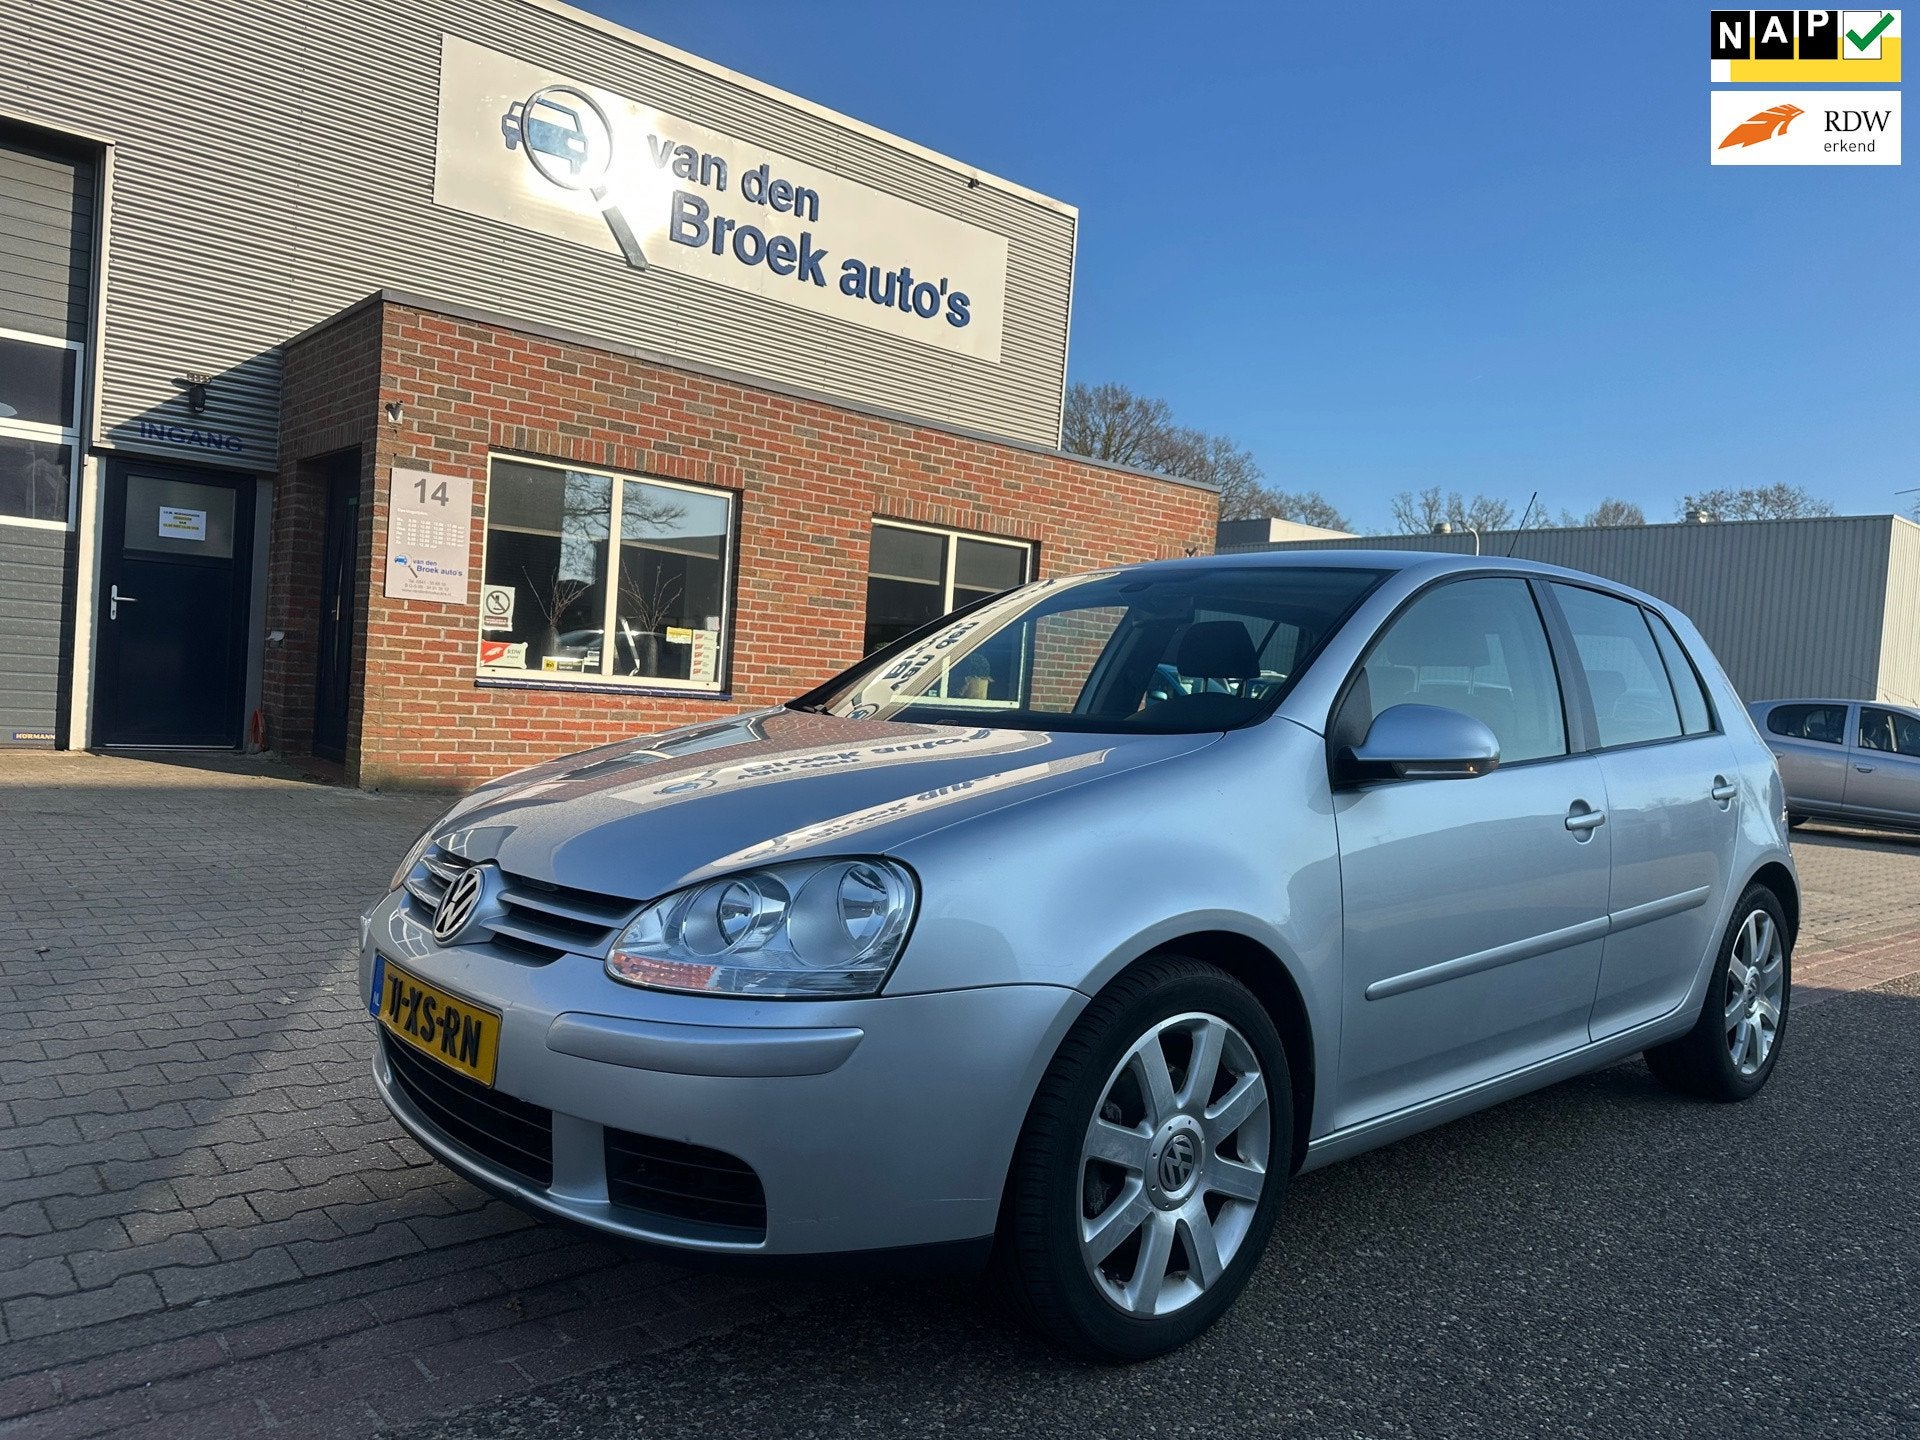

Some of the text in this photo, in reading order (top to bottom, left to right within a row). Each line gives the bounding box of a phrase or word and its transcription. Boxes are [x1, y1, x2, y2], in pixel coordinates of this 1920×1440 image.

[647, 133, 819, 222] van den
[669, 189, 971, 328] Broek auto's
[140, 421, 242, 452] INGANG
[414, 478, 449, 507] 14
[417, 565, 463, 577] Broek auto's
